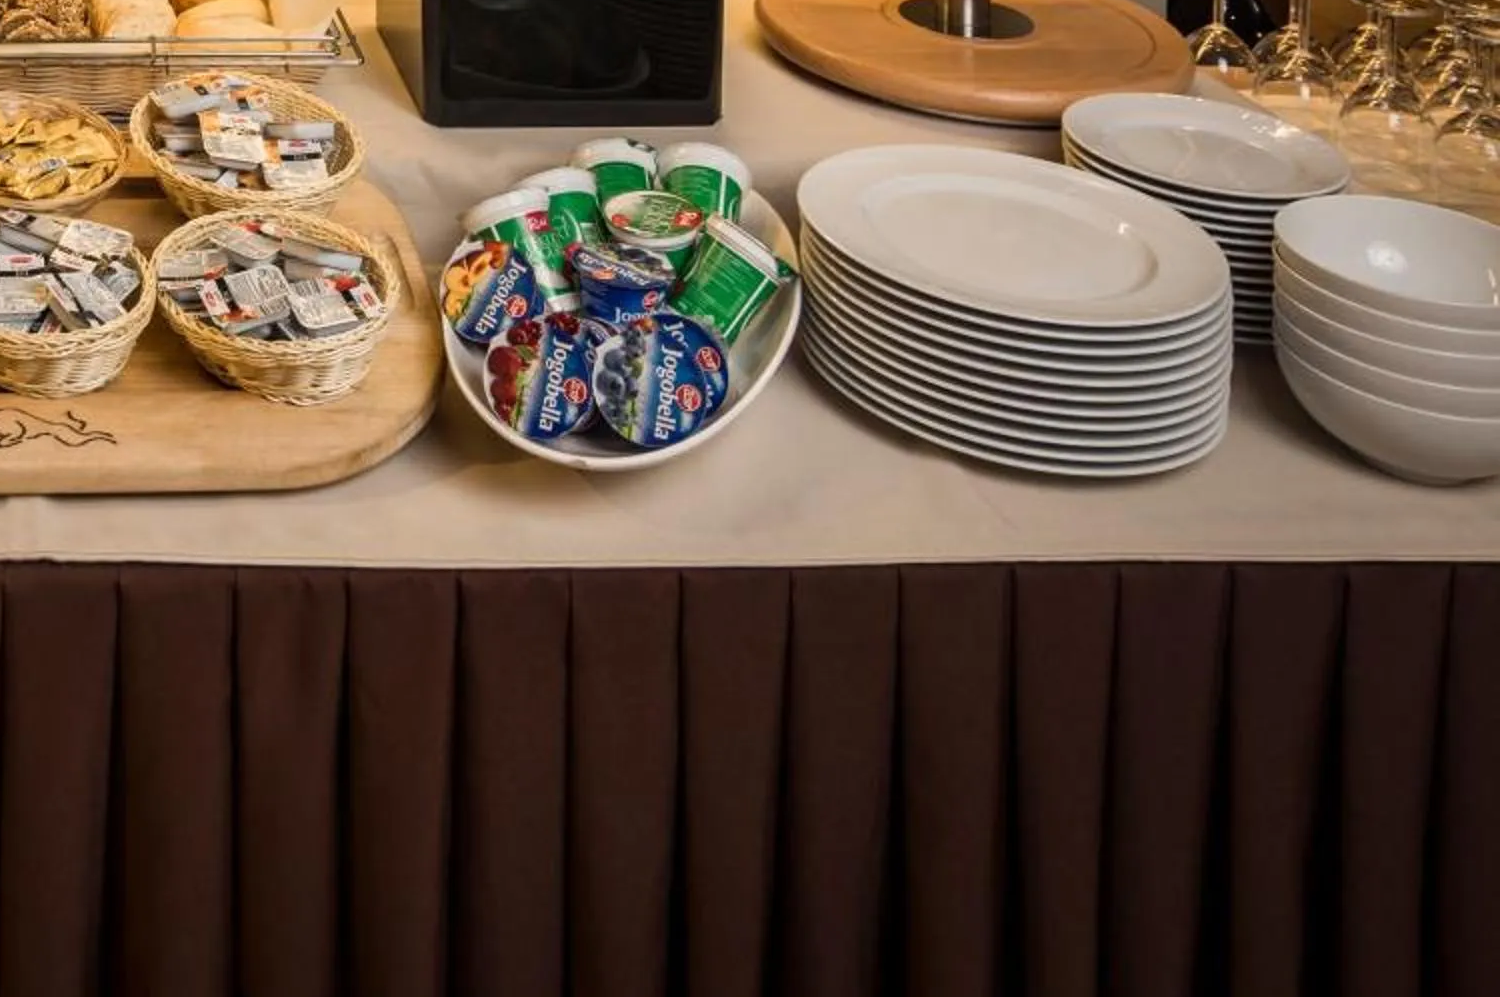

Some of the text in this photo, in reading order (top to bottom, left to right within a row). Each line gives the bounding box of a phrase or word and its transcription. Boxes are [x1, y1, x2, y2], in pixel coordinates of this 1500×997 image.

[475, 259, 528, 335] Jogobella
[539, 338, 575, 432] Jogobella
[654, 345, 684, 441] Jogobella
